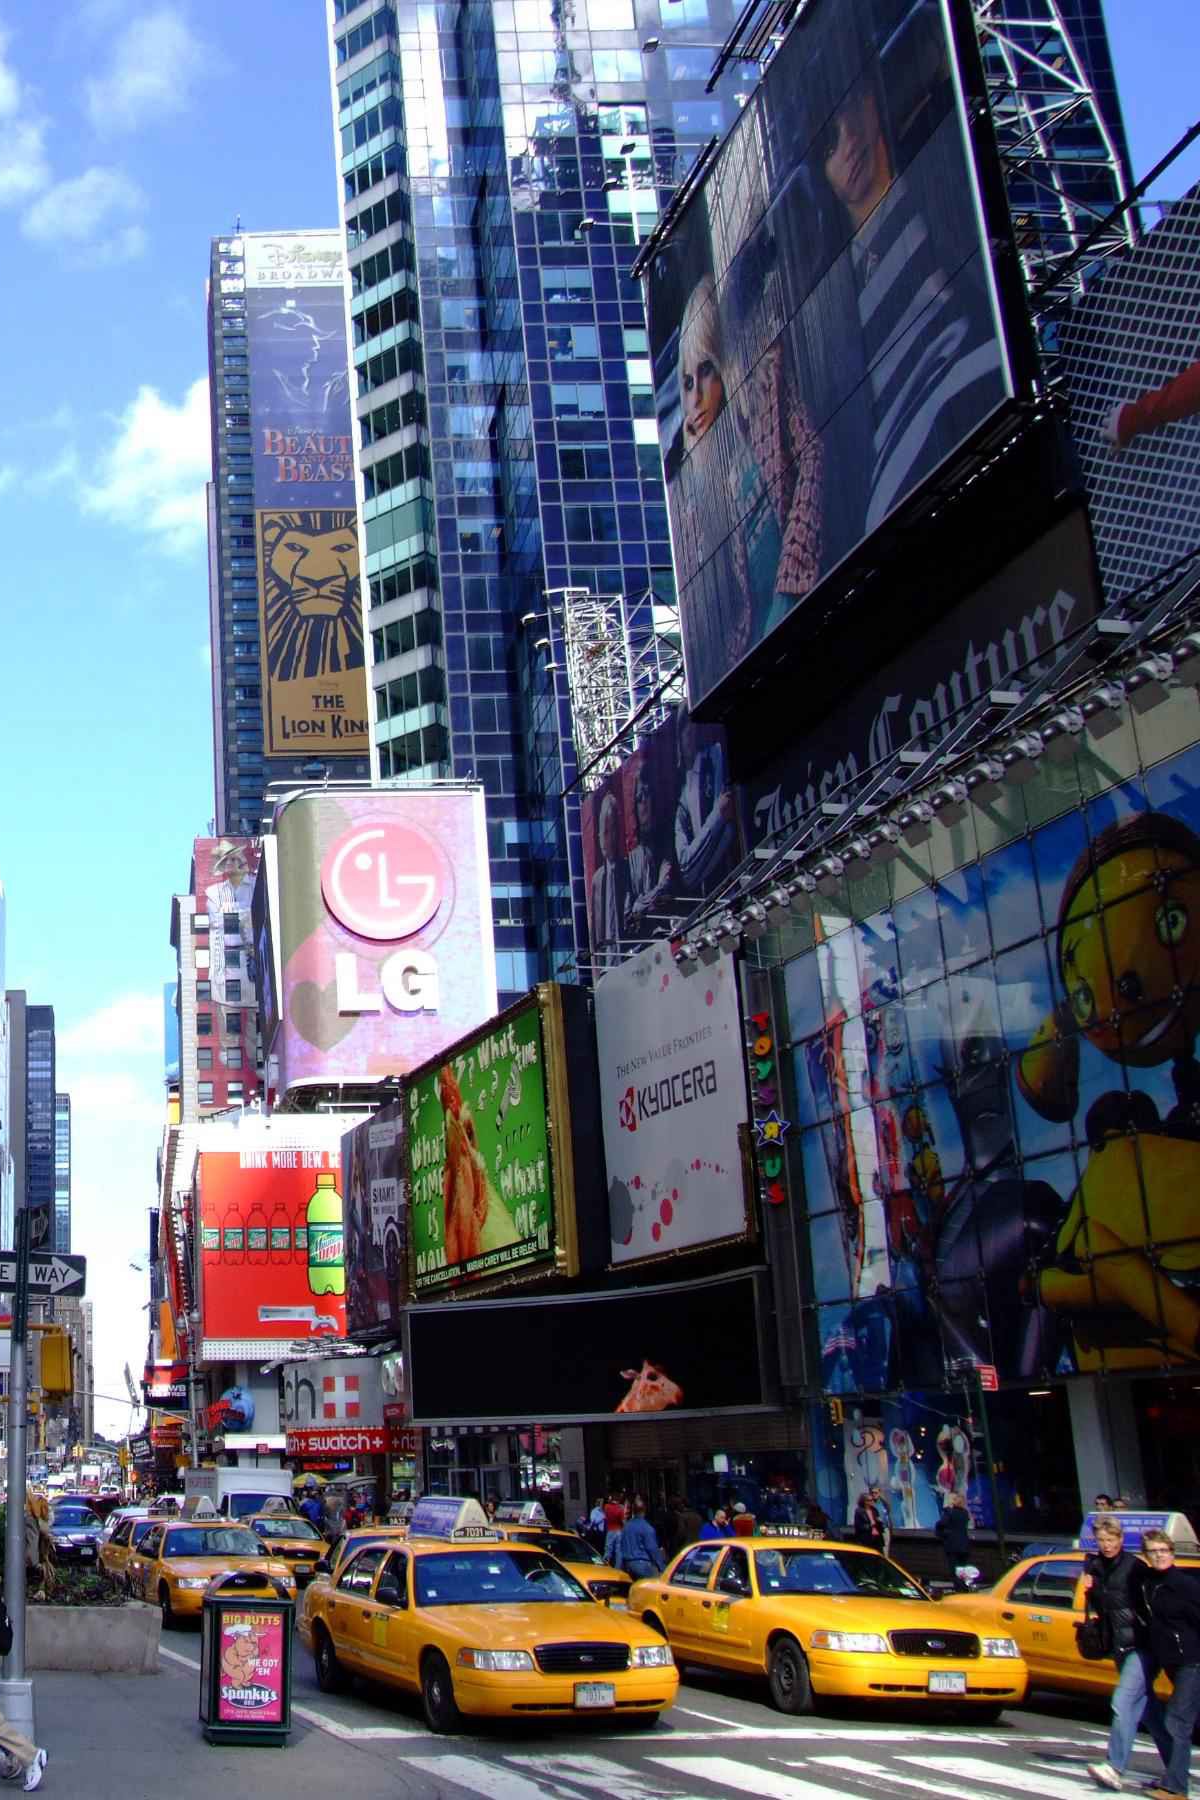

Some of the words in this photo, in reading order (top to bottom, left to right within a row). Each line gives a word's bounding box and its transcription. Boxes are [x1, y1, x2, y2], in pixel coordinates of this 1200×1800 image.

[257, 271, 343, 280] BROADWA
[262, 429, 352, 456] BEAUT
[312, 694, 345, 708] THE
[281, 715, 325, 739] LION
[335, 949, 440, 1017] LG
[648, 1043, 672, 1062] VALUE
[637, 1060, 717, 1121] KYOCERA
[271, 1151, 298, 1168] MORE
[34, 1266, 70, 1283] WAY
[308, 1433, 370, 1452] swatch
[223, 1615, 241, 1625] BIG
[245, 1615, 281, 1625] BUTTS
[262, 1658, 278, 1667] GOT
[222, 1685, 278, 1703] Spanky's
